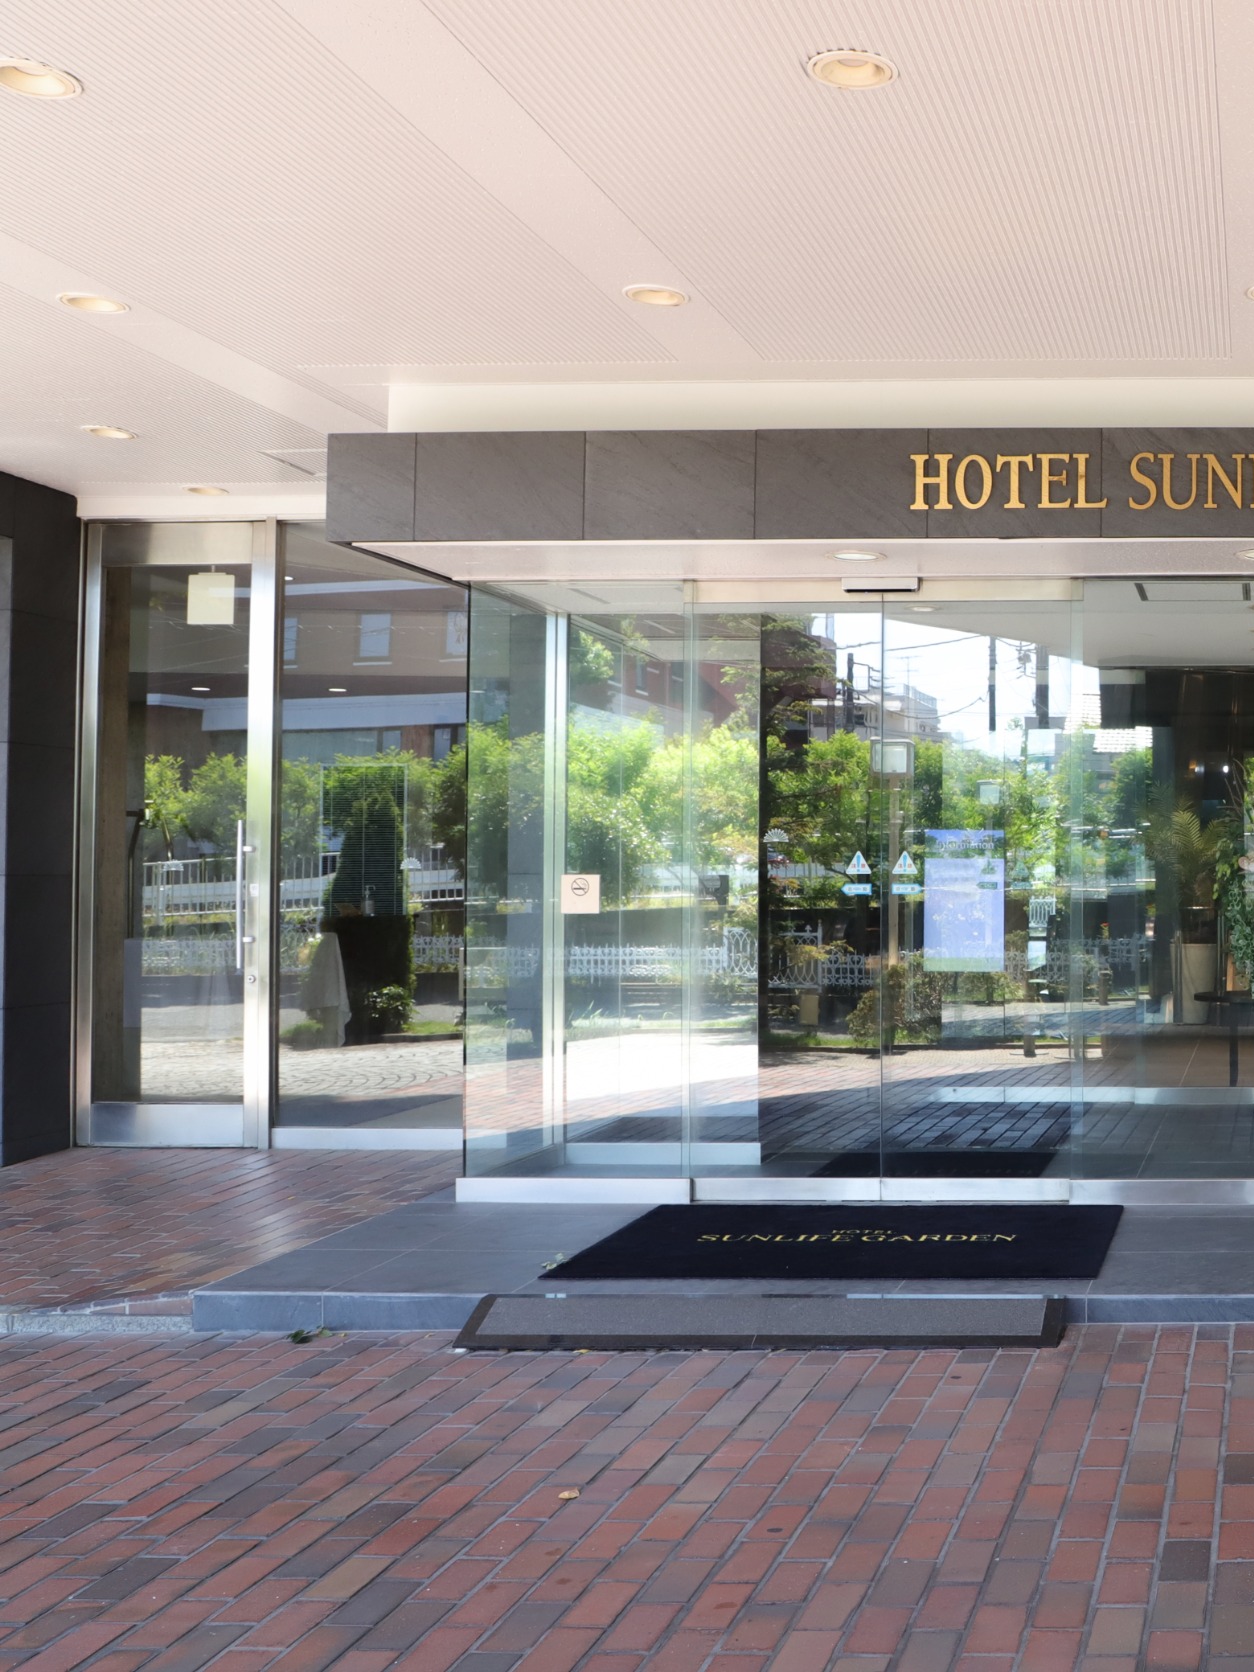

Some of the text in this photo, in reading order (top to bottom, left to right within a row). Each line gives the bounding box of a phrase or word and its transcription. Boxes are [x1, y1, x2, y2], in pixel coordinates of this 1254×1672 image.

[909, 452, 1108, 511] HOTEL
[697, 1234, 1017, 1242] SUNLIFE GARDEN
